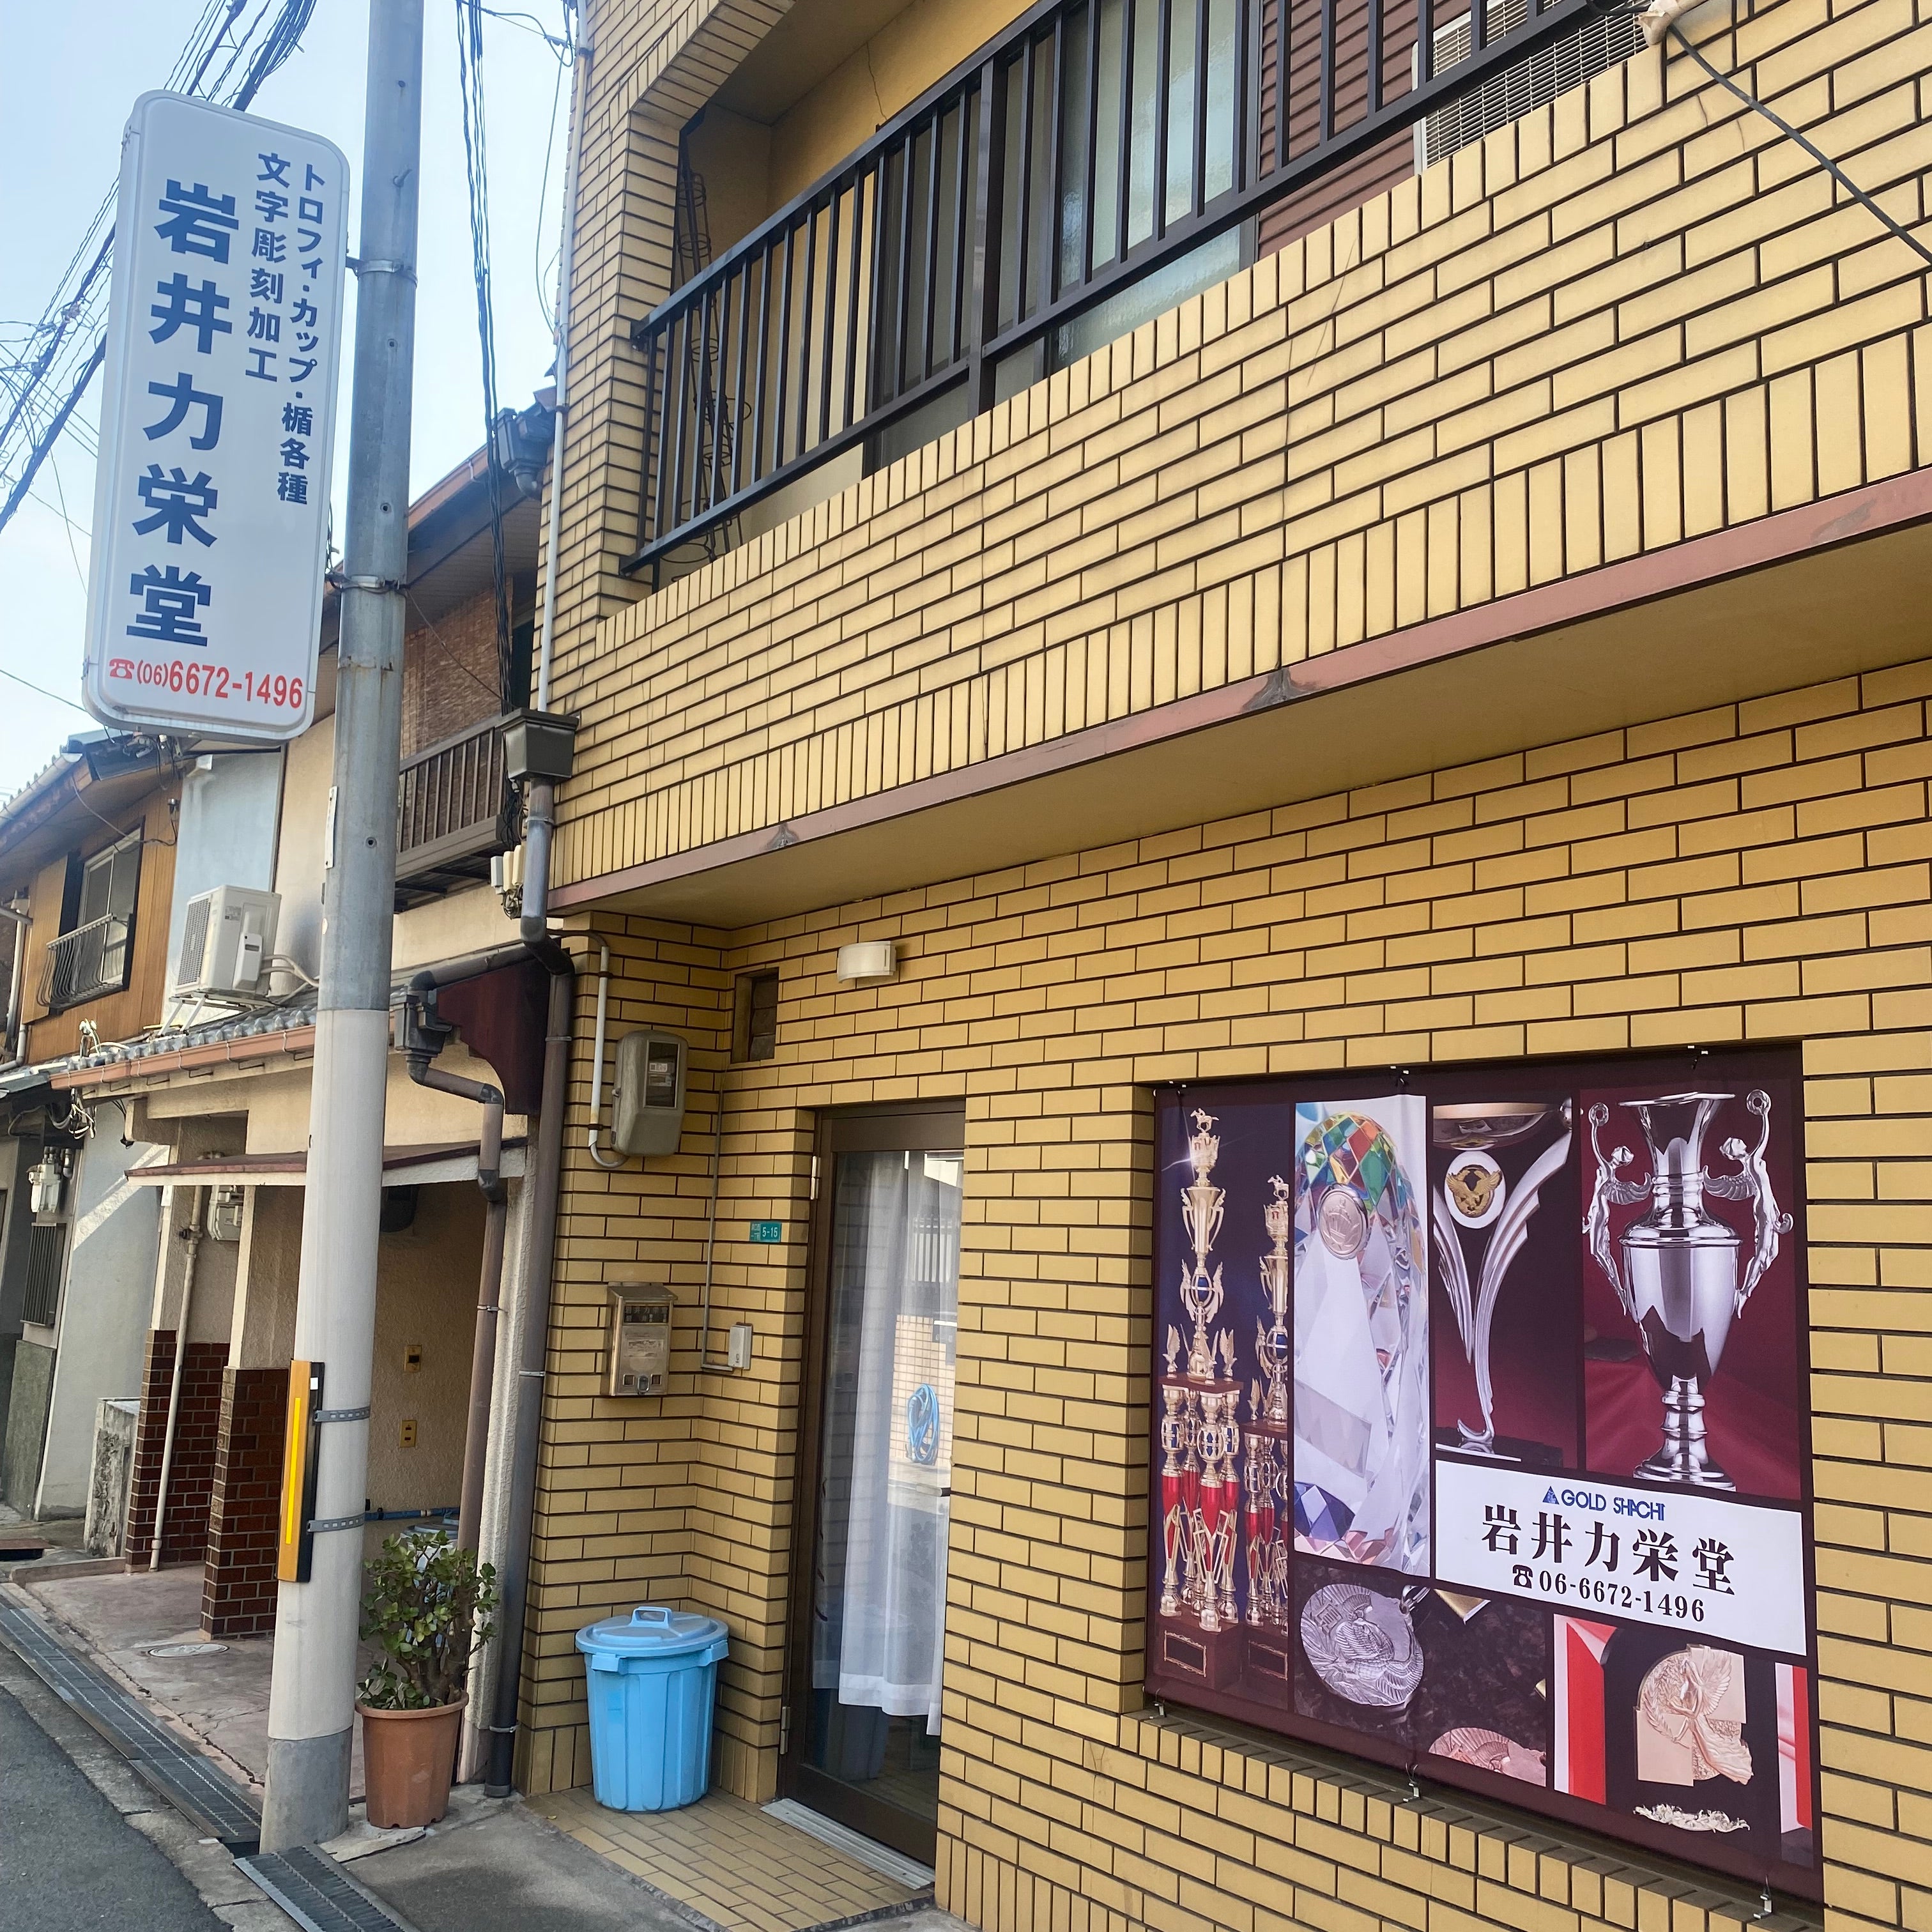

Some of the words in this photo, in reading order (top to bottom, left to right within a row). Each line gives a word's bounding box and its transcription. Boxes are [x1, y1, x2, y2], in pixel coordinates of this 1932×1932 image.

[245, 152, 291, 383] 文字彫刻加工
[126, 178, 240, 647] 岩井力栄堂
[137, 659, 303, 709] (06)6672-1496
[1561, 1489, 1607, 1512] GOLD
[1613, 1497, 1666, 1521] SHACHI
[1482, 1504, 1735, 1595] 岩井力栄堂
[1539, 1570, 1705, 1622] 06-6672-1496
